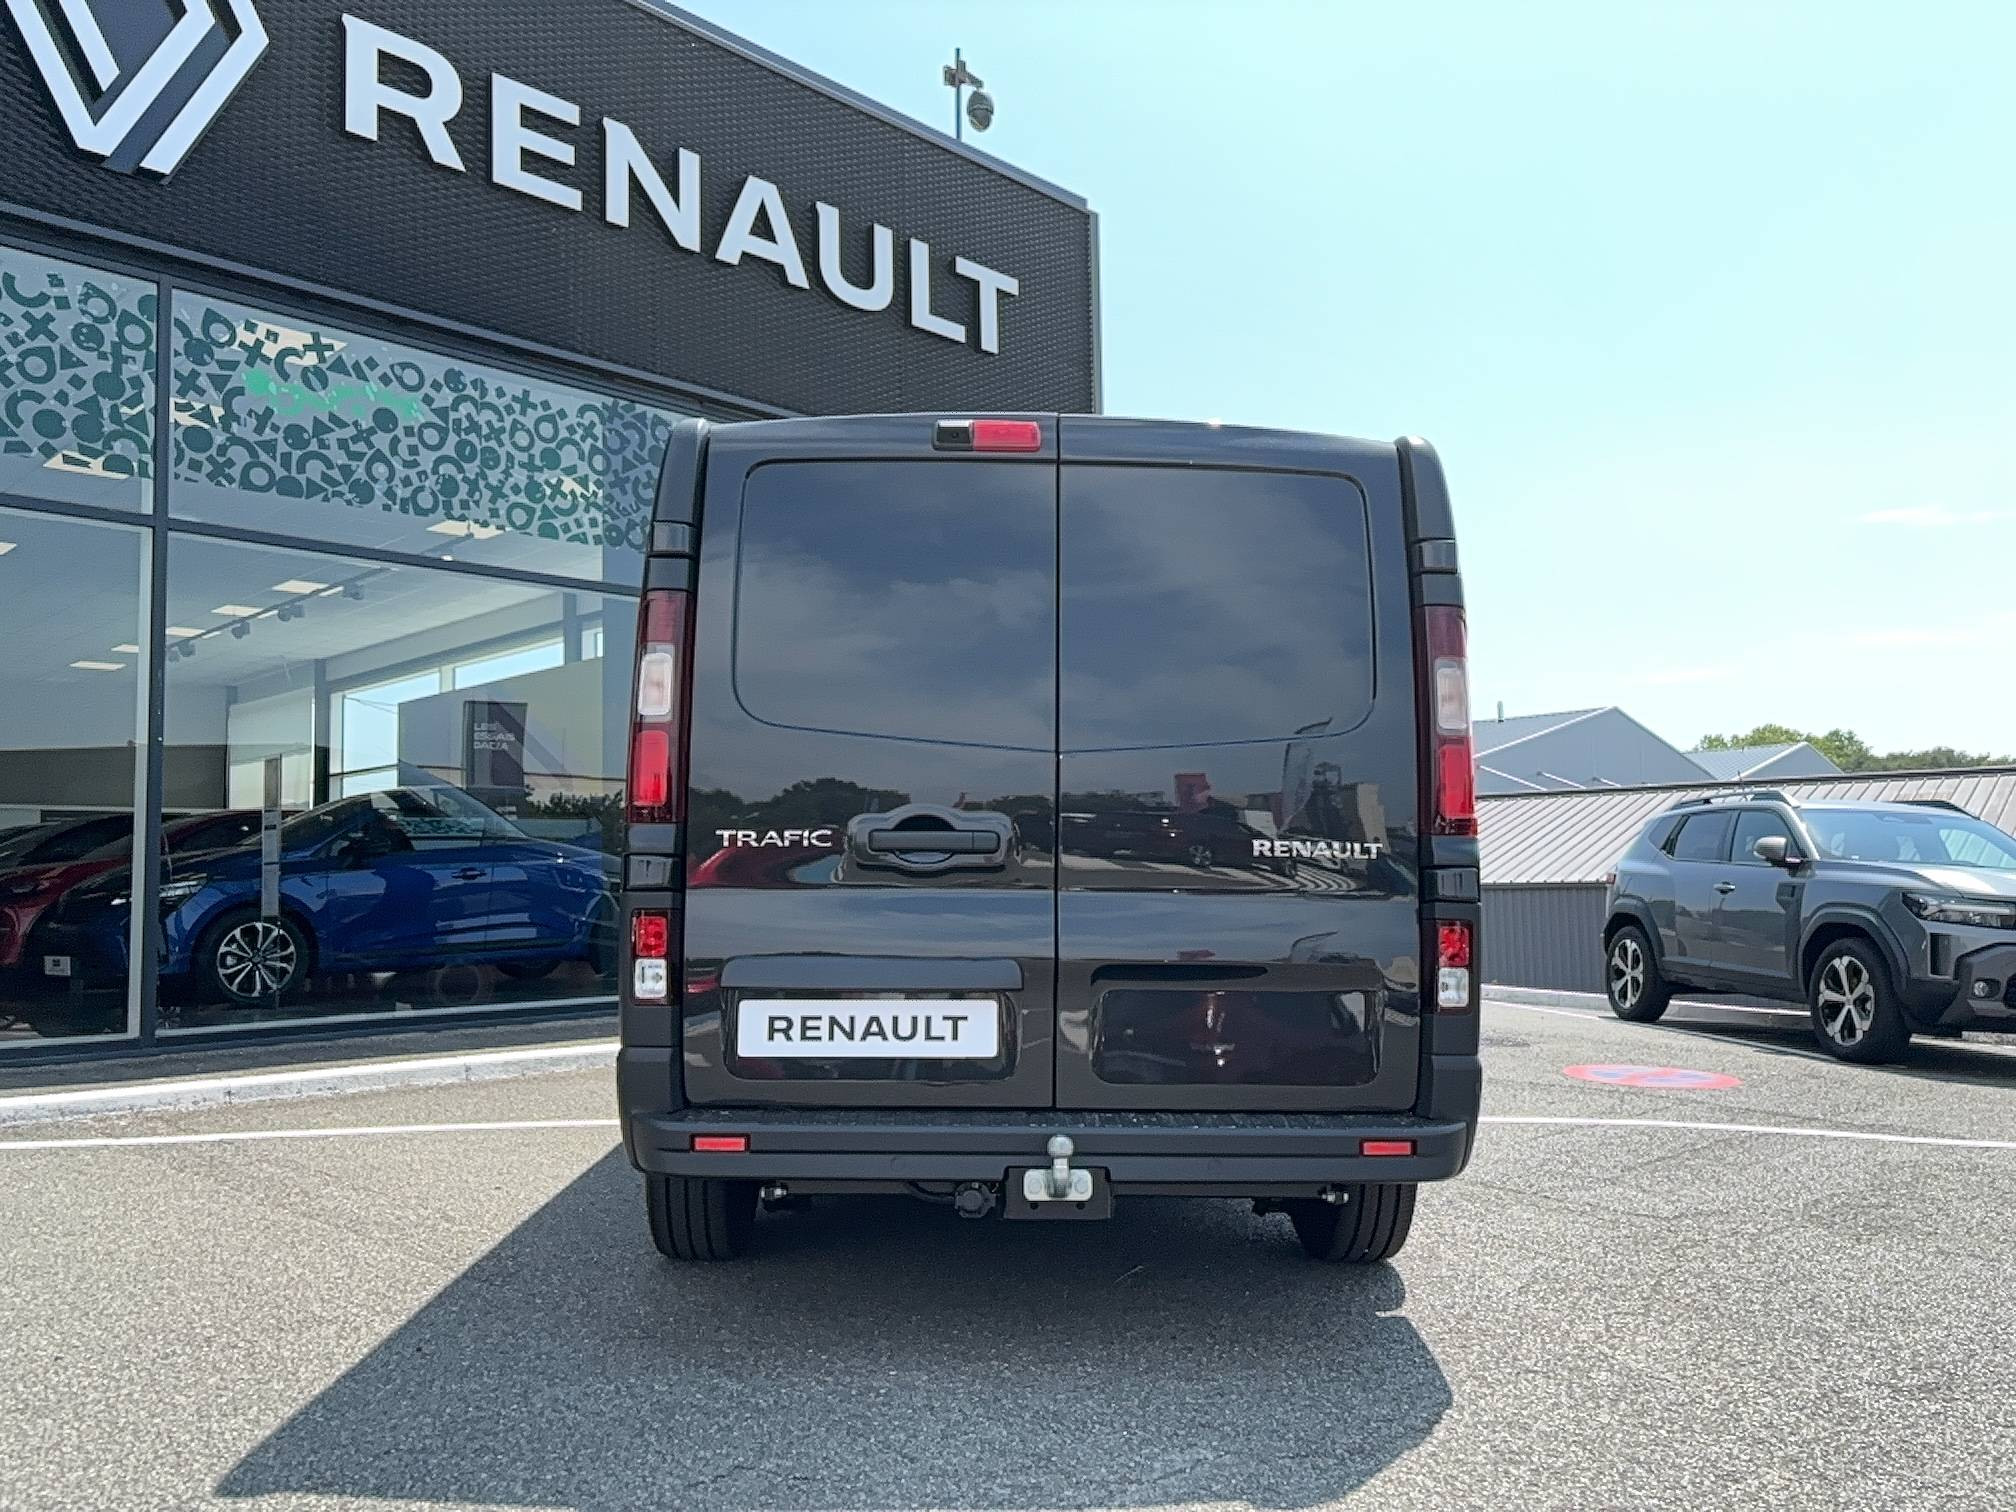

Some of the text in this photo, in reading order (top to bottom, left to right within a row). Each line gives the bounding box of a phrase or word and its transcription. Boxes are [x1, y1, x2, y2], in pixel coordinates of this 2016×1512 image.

[341, 13, 1020, 355] RENAULT
[715, 829, 833, 848] TRAFIC
[1251, 839, 1383, 860] RENAULT
[767, 1015, 968, 1042] RENAULT
